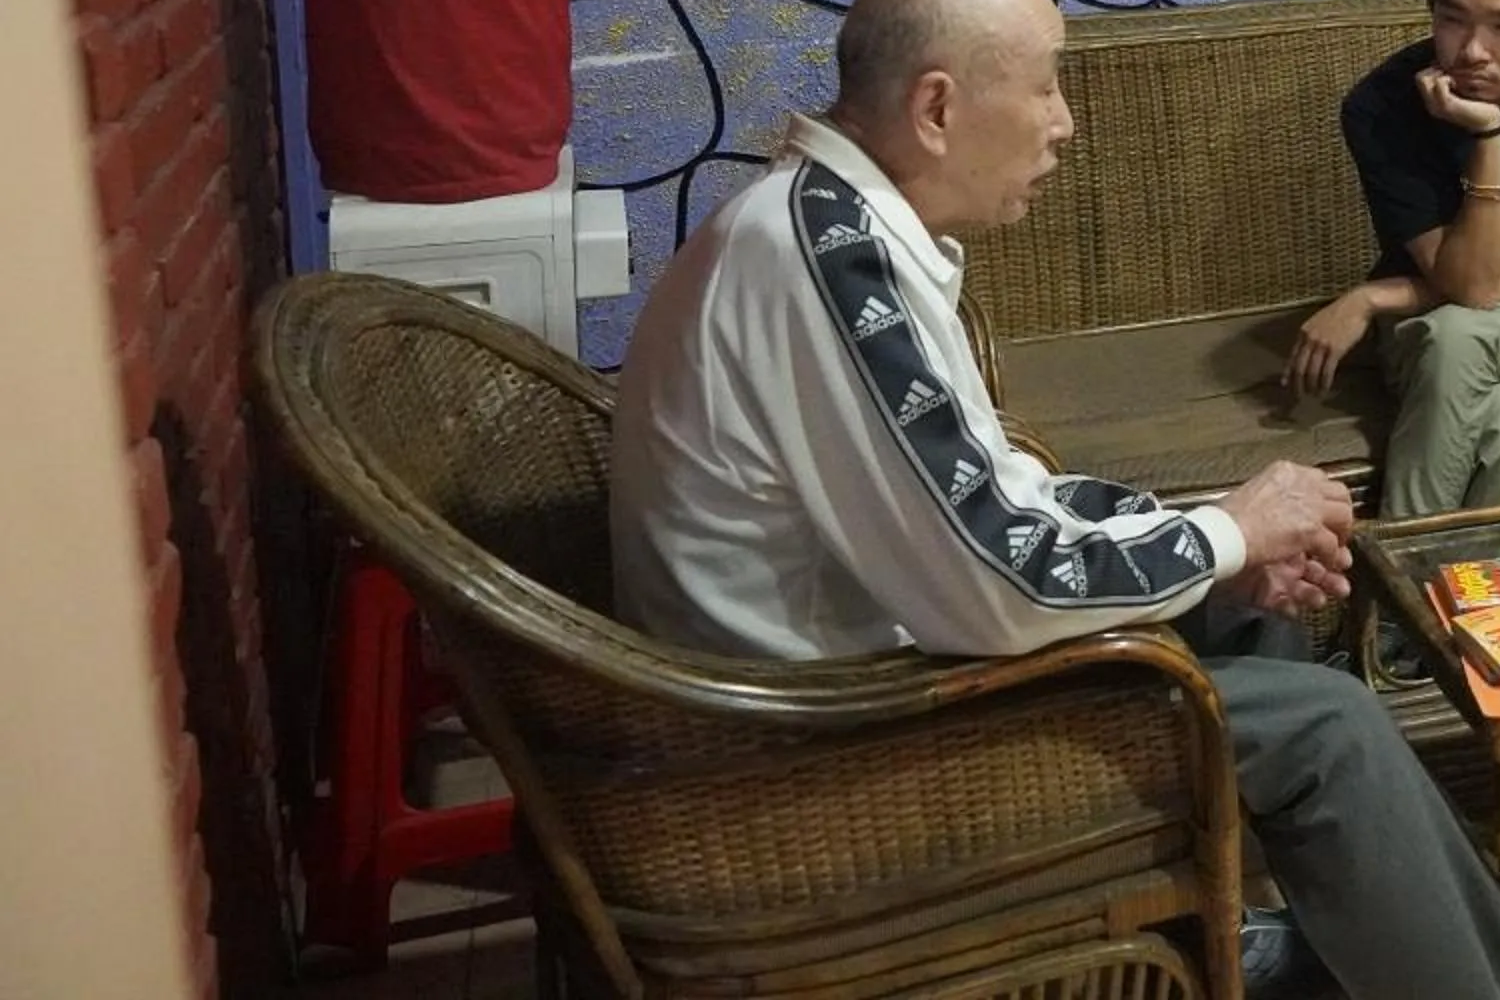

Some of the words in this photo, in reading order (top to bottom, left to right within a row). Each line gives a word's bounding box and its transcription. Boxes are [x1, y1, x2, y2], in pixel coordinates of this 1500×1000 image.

[852, 311, 906, 341] adidas
[897, 391, 949, 427] adidas
[949, 471, 990, 506] adidas
[1011, 520, 1049, 571] adidas
